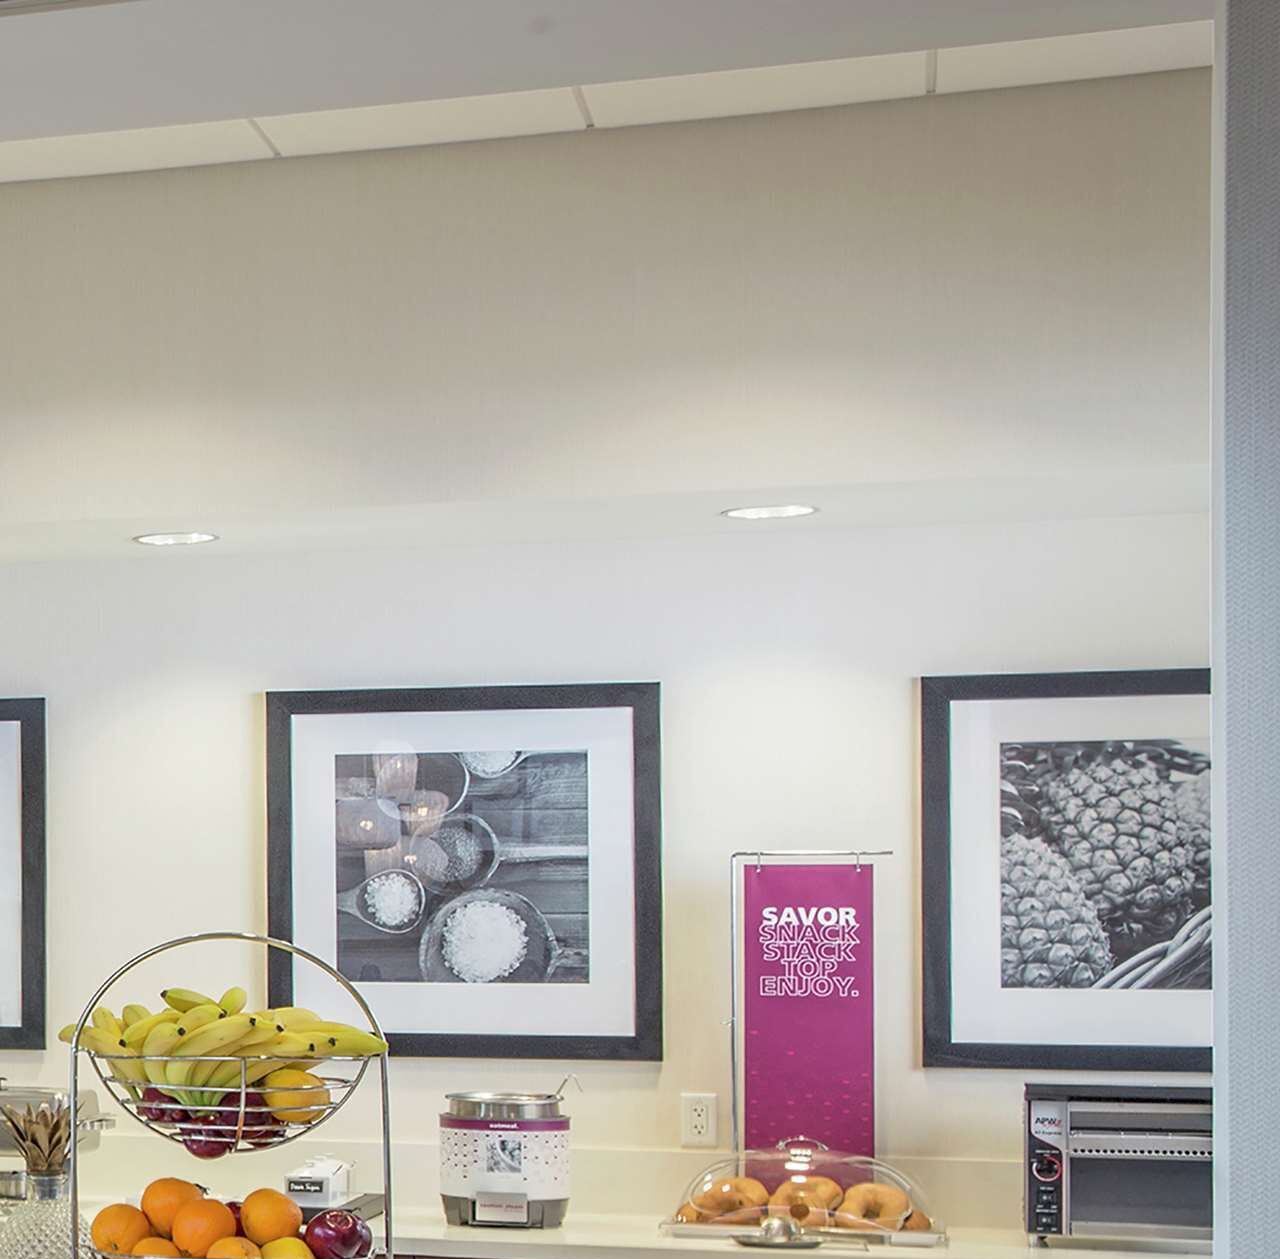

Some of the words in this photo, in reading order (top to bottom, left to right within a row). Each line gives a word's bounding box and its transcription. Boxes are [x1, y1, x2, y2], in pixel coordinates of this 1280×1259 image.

[762, 907, 857, 926] SAVOR
[759, 923, 860, 944] SNACK
[762, 942, 857, 961] STACK
[780, 958, 838, 979] TOP
[759, 976, 860, 997] ENJOY.
